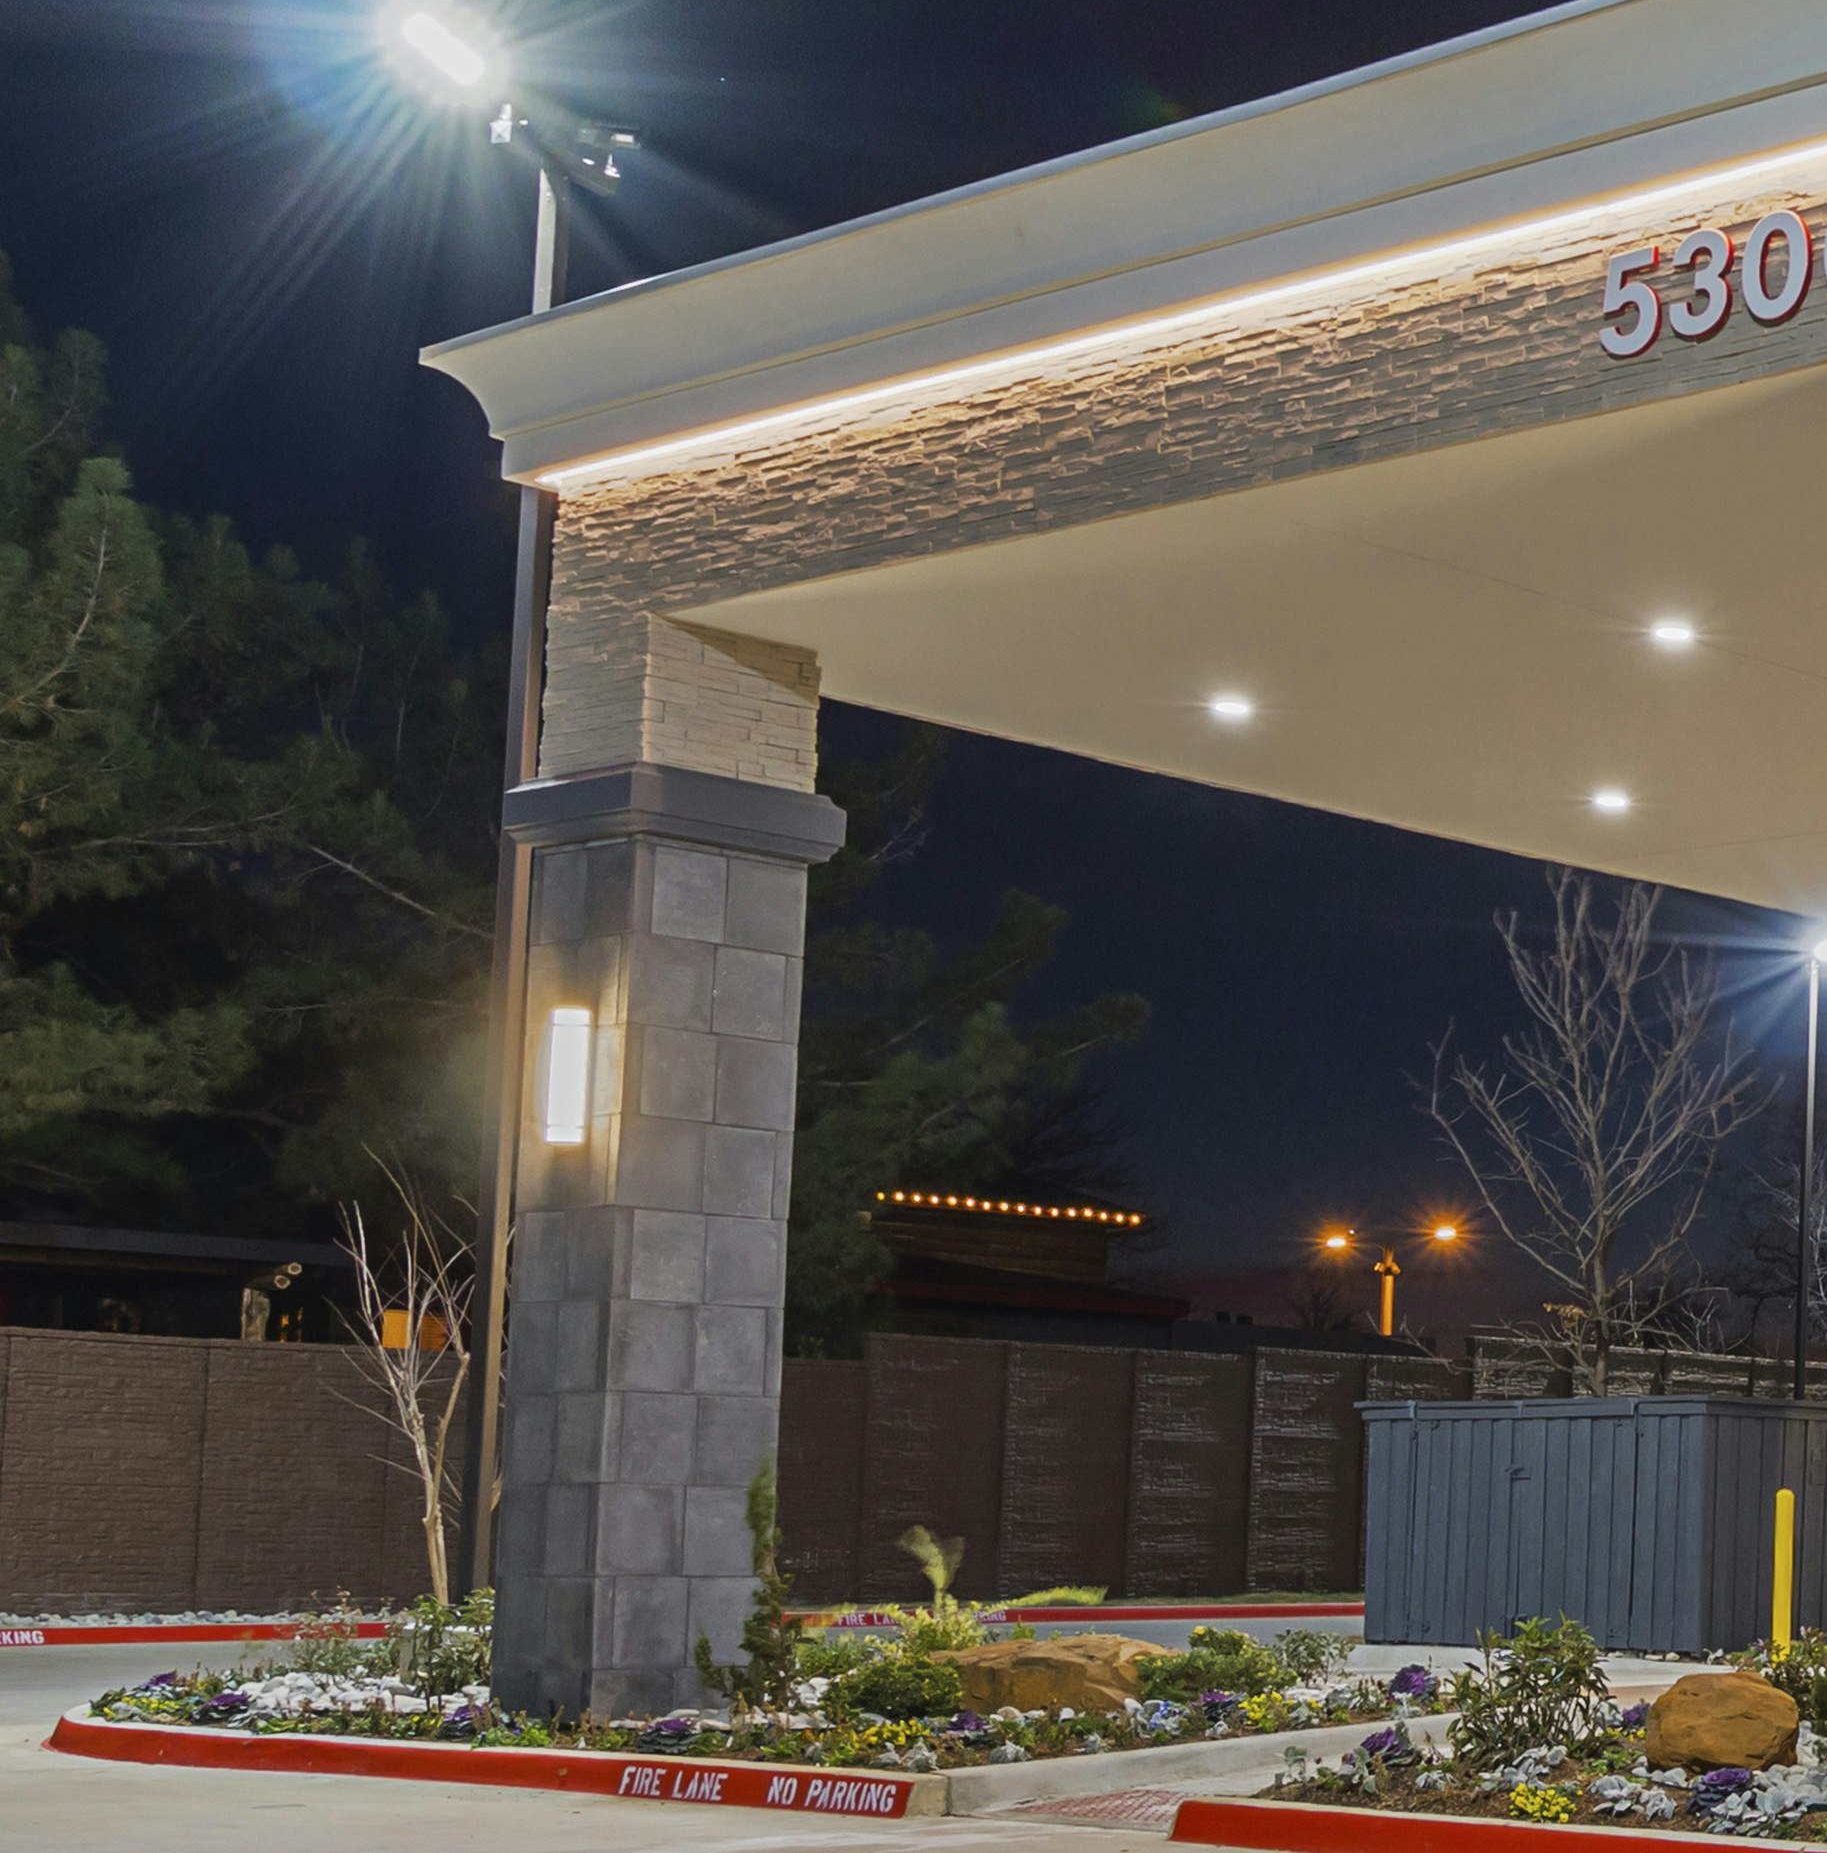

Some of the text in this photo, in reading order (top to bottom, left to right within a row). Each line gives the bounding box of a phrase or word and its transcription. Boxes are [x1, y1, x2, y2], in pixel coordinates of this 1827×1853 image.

[838, 1612, 866, 1626] FIRE
[873, 1613, 899, 1626] LA
[0, 1630, 45, 1644] KING
[619, 1765, 896, 1813] FIRE LANE NO PARKING
